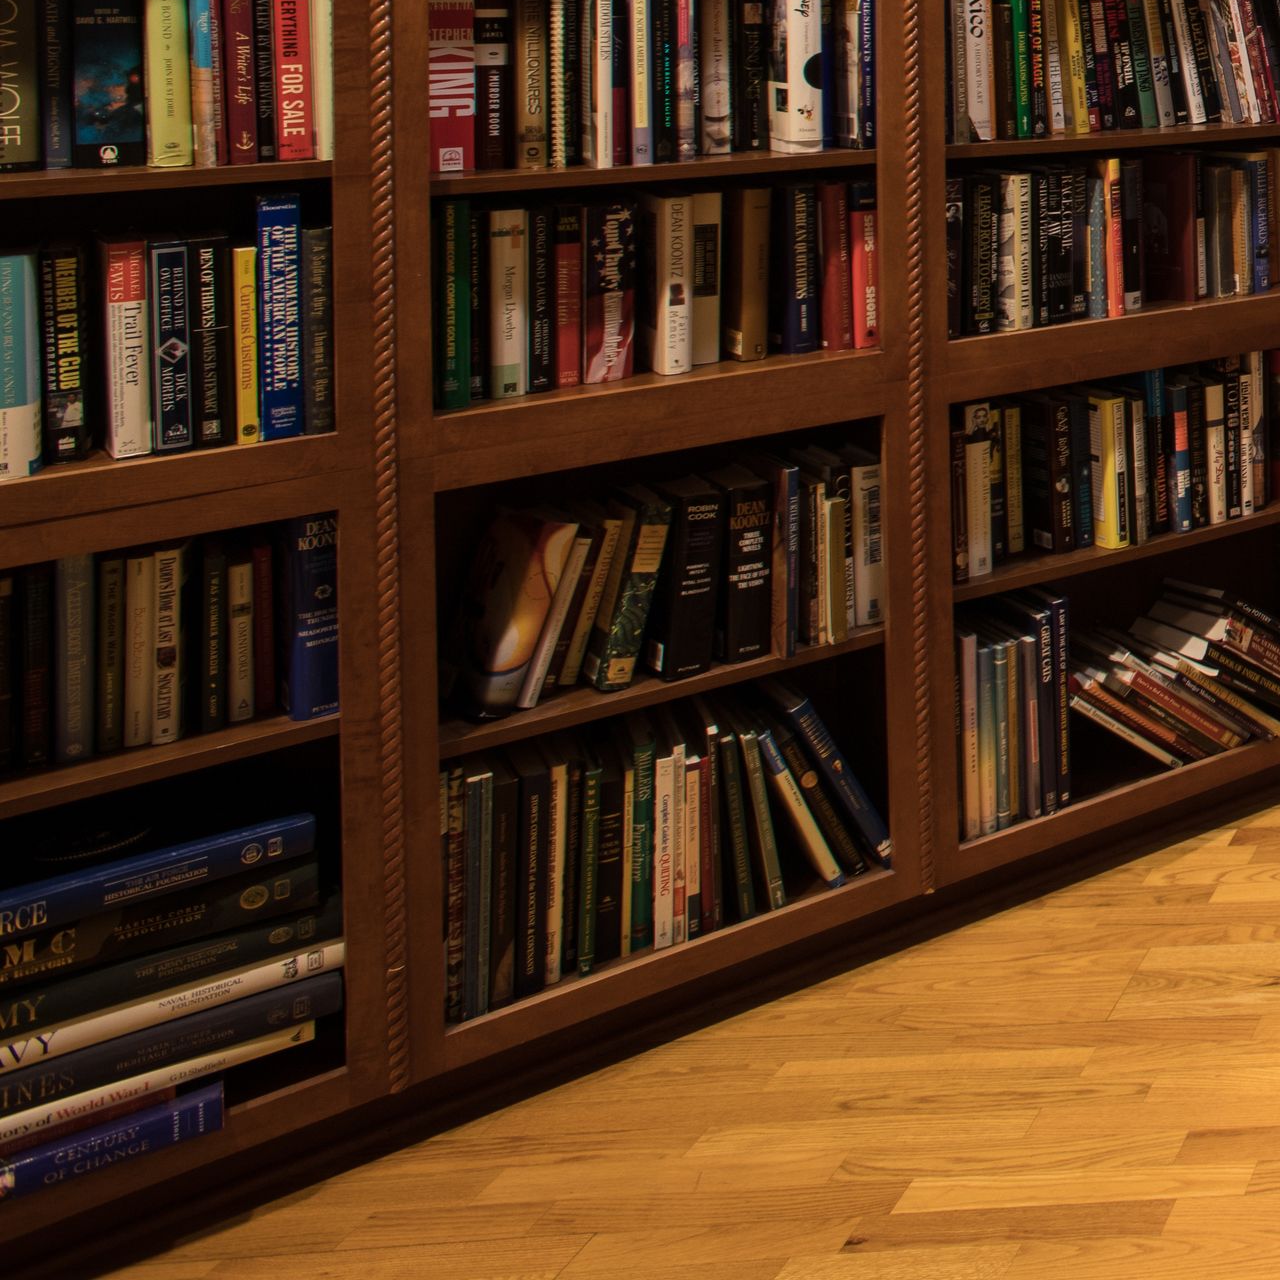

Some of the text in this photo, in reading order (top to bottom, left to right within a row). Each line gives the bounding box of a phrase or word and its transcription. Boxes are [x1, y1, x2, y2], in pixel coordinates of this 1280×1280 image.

[281, 64, 303, 94] FOR
[429, 47, 475, 117] KING
[526, 26, 541, 115] MILLIONAIRES
[282, 98, 304, 137] SALE
[488, 111, 499, 136] ROOM
[671, 204, 684, 277] DEAN KOONTZ
[110, 251, 128, 300] LEWIS
[129, 249, 141, 295] MICHAEL
[160, 268, 172, 331] OVAL OFFICE
[172, 268, 185, 329] BEHIND THE
[201, 284, 216, 328] THIEVES
[271, 225, 287, 392] OF THE AMERICAN PEOPLE
[284, 224, 299, 382] THE LANDMARK HISTORY
[55, 257, 80, 390] MEMBER OF THE CLUB
[124, 303, 142, 385] Trail Fever
[163, 367, 175, 411] MORRIS
[175, 374, 186, 399] DICK
[730, 511, 770, 530] KOONTZ
[737, 499, 766, 515] DEAN
[51, 928, 76, 954] C
[159, 978, 243, 1008] NAVAL HISTORICAL
[171, 988, 231, 1011] FOUNDATION
[56, 1099, 105, 1119] World
[108, 1086, 142, 1107] War
[45, 1141, 149, 1183] OF CHANGE
[55, 1127, 140, 1164] CENTURY
